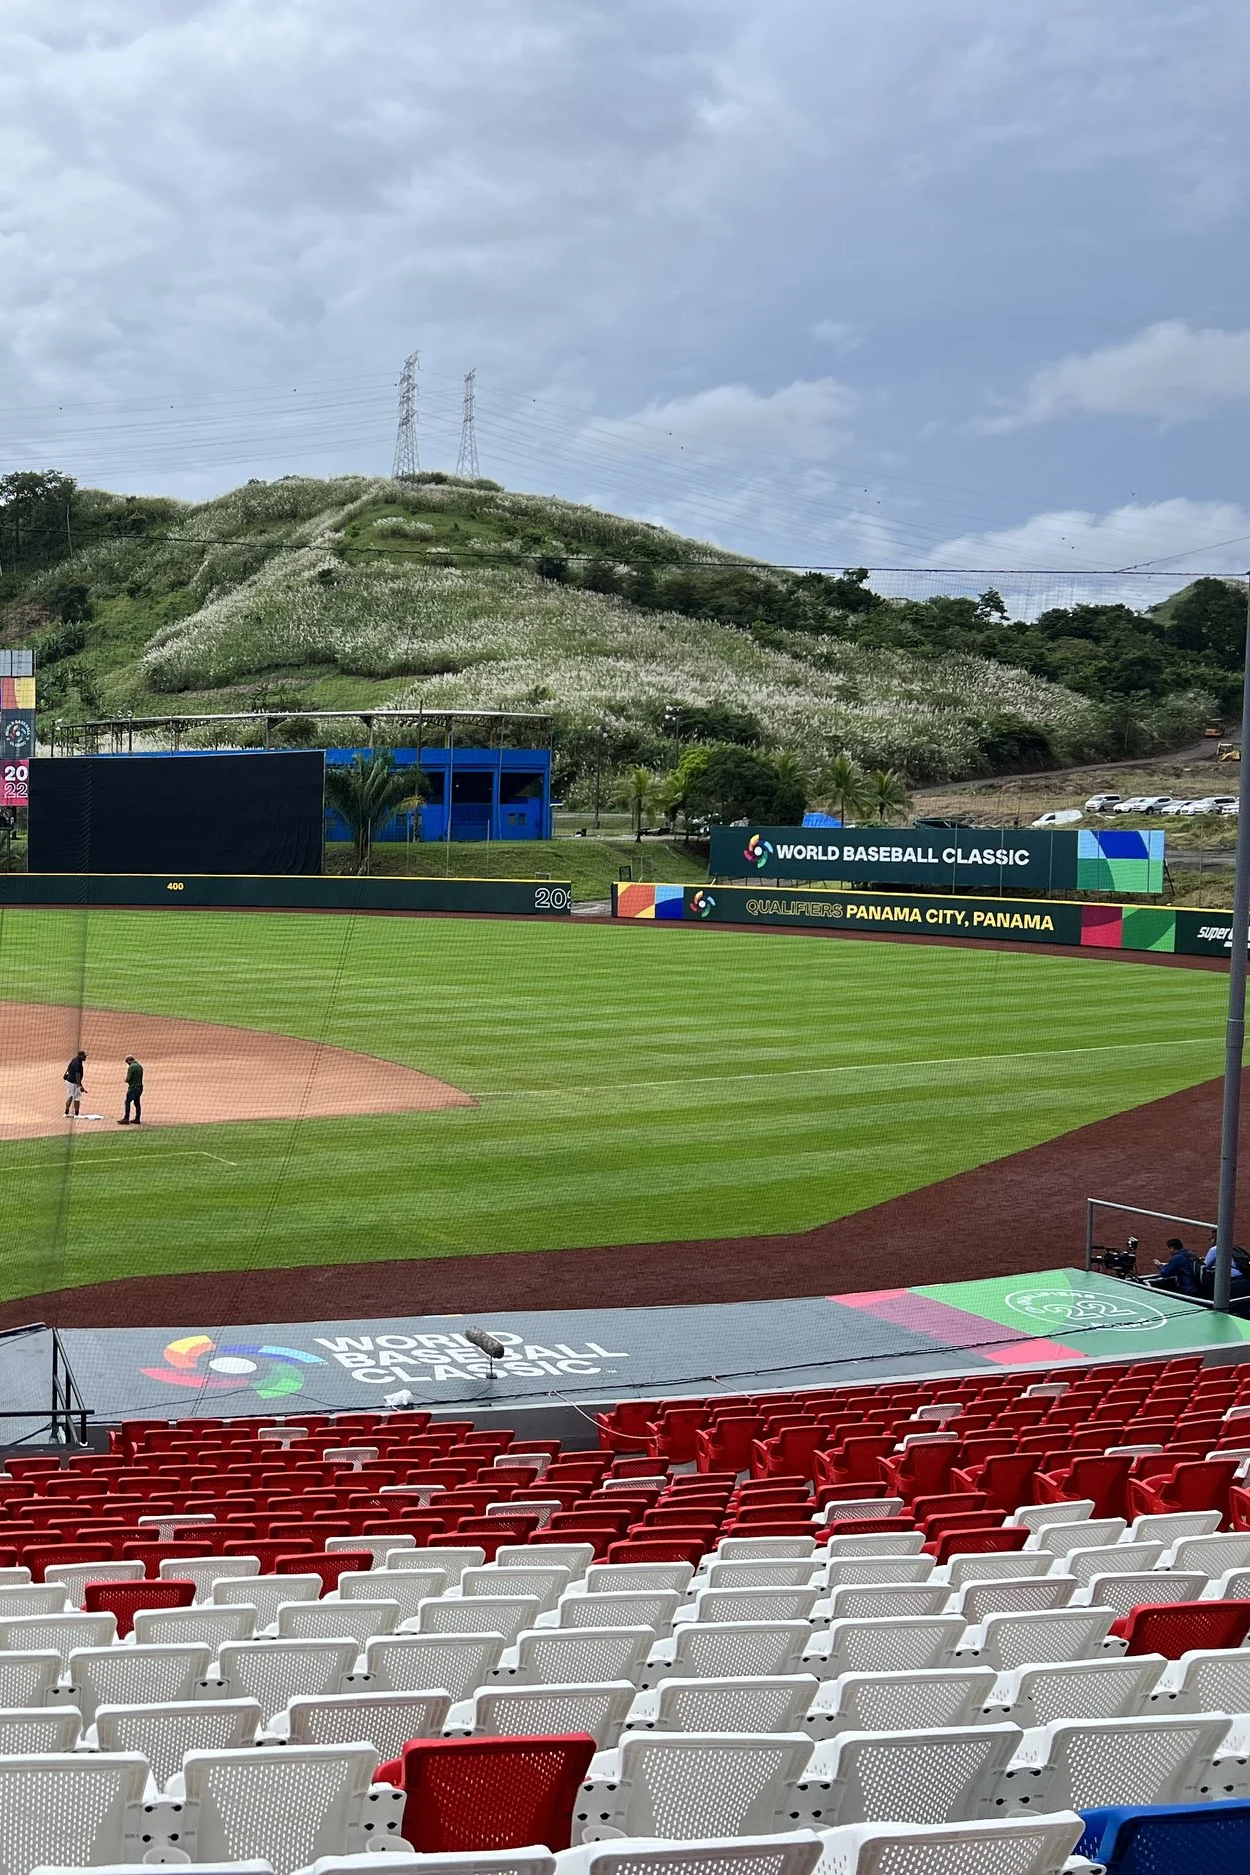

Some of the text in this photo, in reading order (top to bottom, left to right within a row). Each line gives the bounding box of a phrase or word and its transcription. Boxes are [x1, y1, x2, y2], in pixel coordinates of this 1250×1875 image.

[4, 766, 28, 781] 20
[4, 782, 28, 798] 22
[776, 844, 1030, 866] WORLD BASEBALL CLASSIC
[167, 882, 184, 891] 400
[535, 887, 571, 910] 20
[746, 899, 1054, 931] QUALIFIERS PANAMA CITY, PANAMA
[314, 1331, 524, 1352] WORLD
[332, 1342, 630, 1368] BASEBALL
[351, 1359, 601, 1384] CLASSIC
